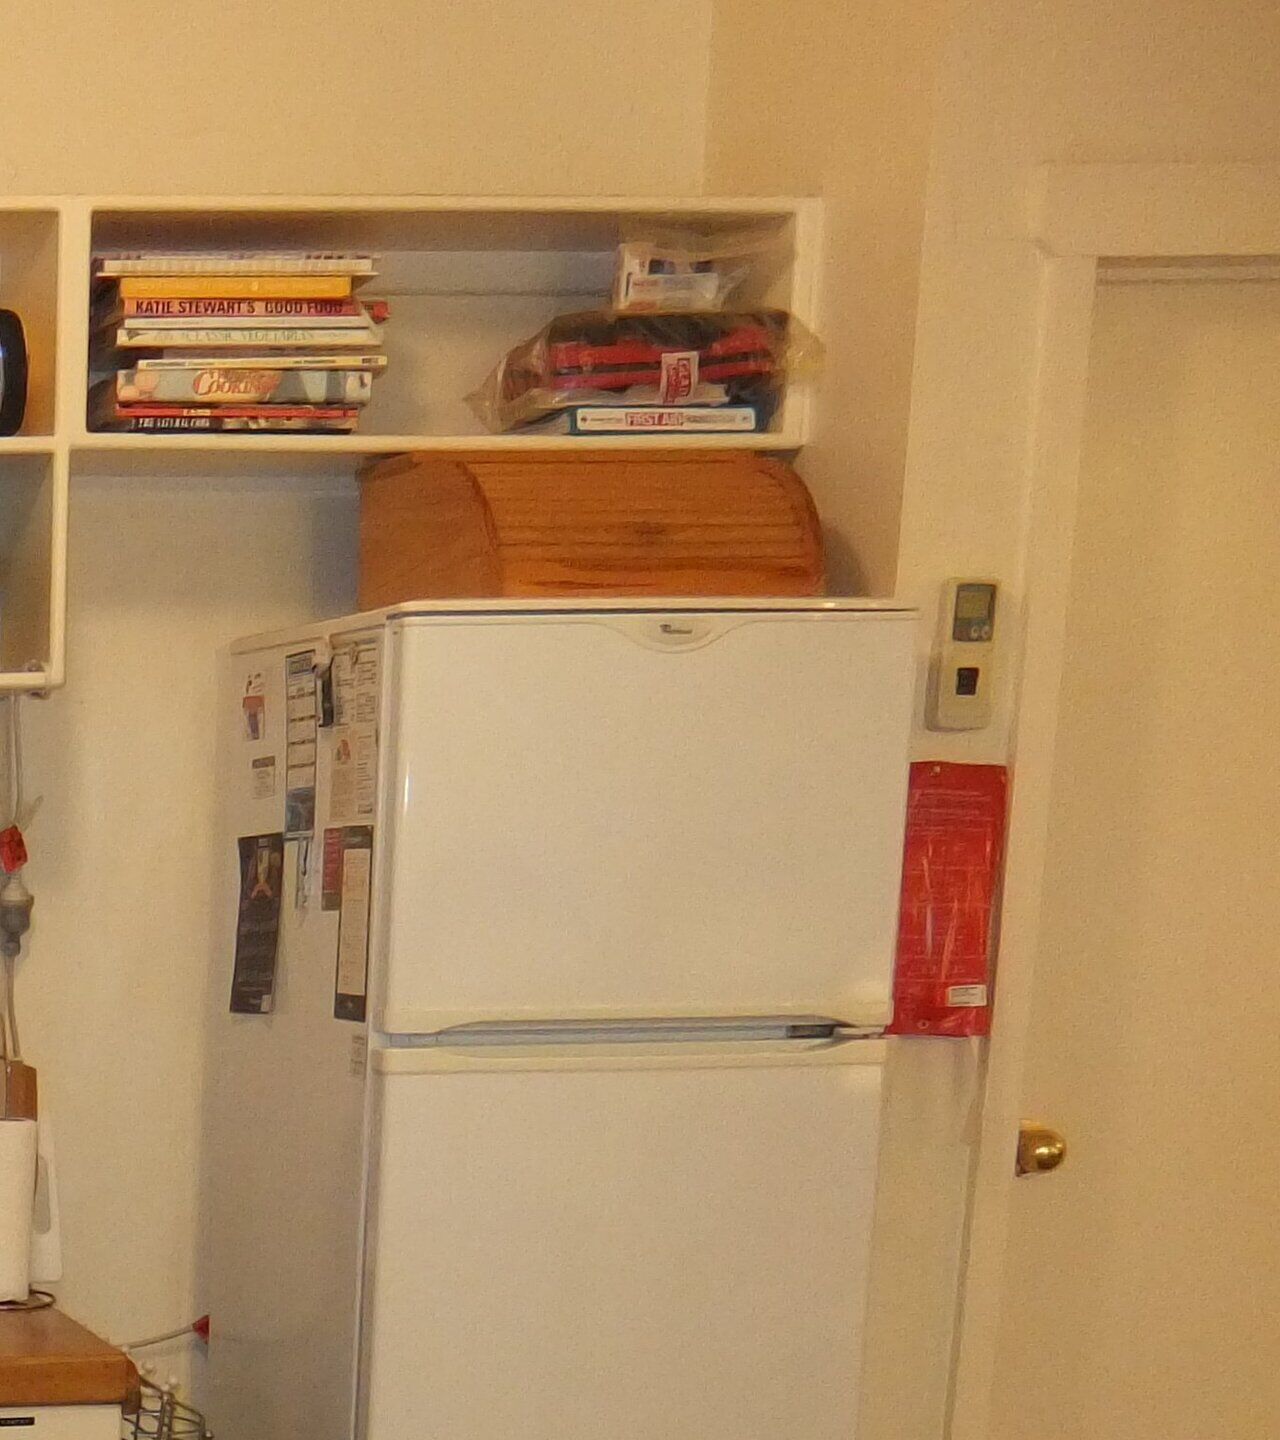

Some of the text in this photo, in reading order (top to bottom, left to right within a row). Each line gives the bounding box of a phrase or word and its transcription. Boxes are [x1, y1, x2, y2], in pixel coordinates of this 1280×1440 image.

[135, 300, 344, 314] KATIE STEWART'S GOOD FOOD
